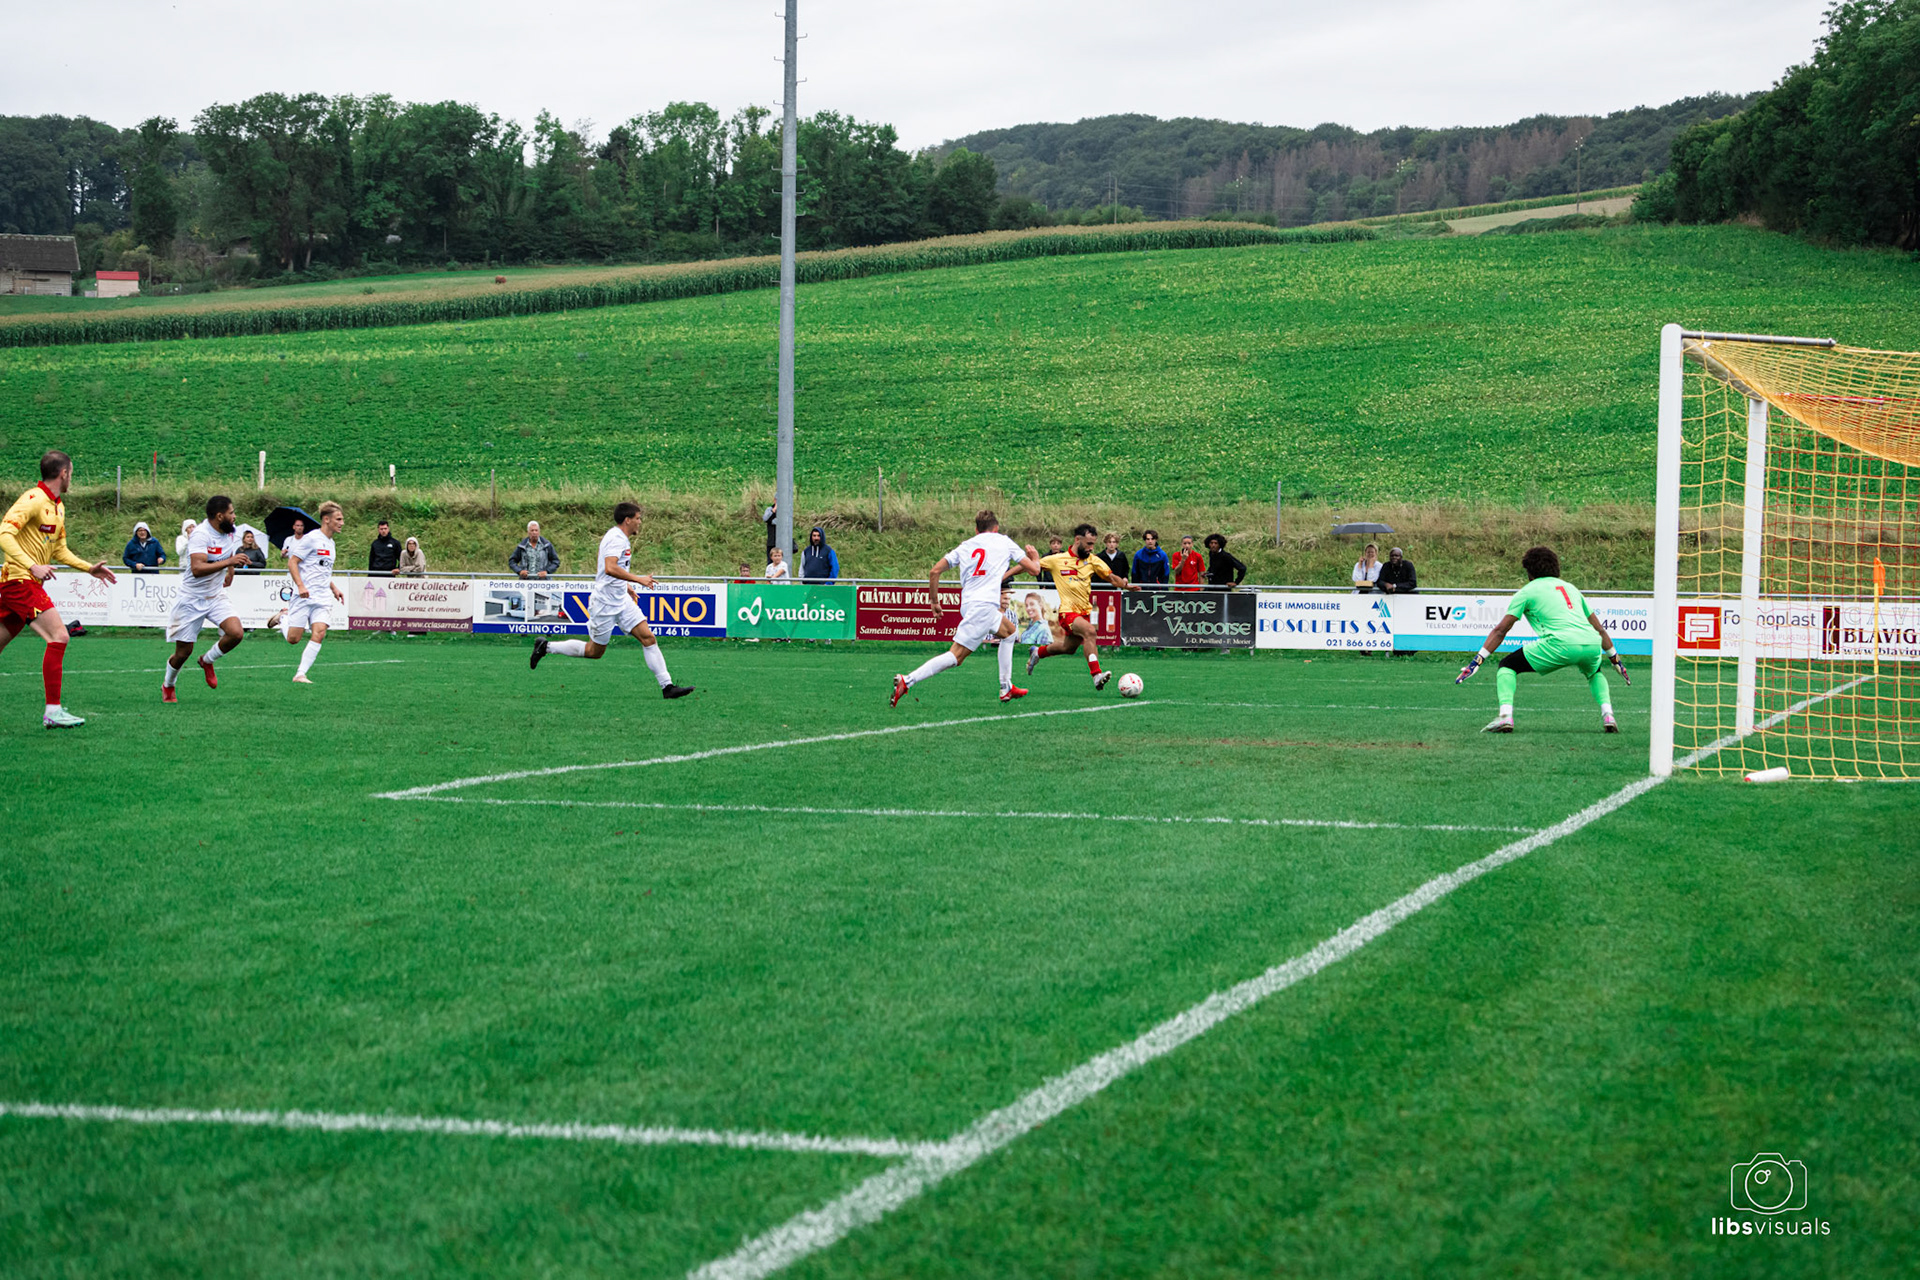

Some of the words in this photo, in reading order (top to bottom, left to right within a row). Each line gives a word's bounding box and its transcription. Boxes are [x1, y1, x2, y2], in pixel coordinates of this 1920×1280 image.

[971, 548, 986, 577] 2
[133, 576, 177, 599] PERUS
[263, 578, 295, 588] pressi
[388, 580, 419, 591] Centre
[421, 581, 469, 592] Collecteur
[489, 580, 513, 589] Portes
[514, 580, 525, 588] de
[527, 581, 560, 590] garages
[564, 582, 589, 591] Portes
[671, 584, 711, 592] industriels
[408, 592, 448, 602] Céréales
[859, 588, 903, 604] CHÂTEAU
[904, 588, 961, 606] D'ÉCLPENS
[1555, 585, 1573, 610] 1
[1258, 600, 1283, 609] RÉGIE
[1285, 600, 1341, 611] IMMOBILIÈRE
[765, 603, 846, 622] vaudoise
[1607, 608, 1647, 616] FRIBOURG
[881, 613, 911, 623] Caveau
[508, 624, 567, 634] VIGLINO.CH
[1259, 618, 1361, 635] BOSQUETS
[1365, 620, 1392, 635] SA
[1621, 619, 1647, 631] 000
[665, 627, 678, 636] 46
[681, 627, 690, 636] 16
[860, 626, 892, 635] Samedis
[893, 627, 920, 636] matins
[922, 627, 936, 636] 10h
[1843, 628, 1920, 645] BLAVIG
[1326, 639, 1342, 647] 021
[1346, 639, 1363, 648] 866
[1366, 640, 1377, 648] 65
[1380, 640, 1392, 648] 66
